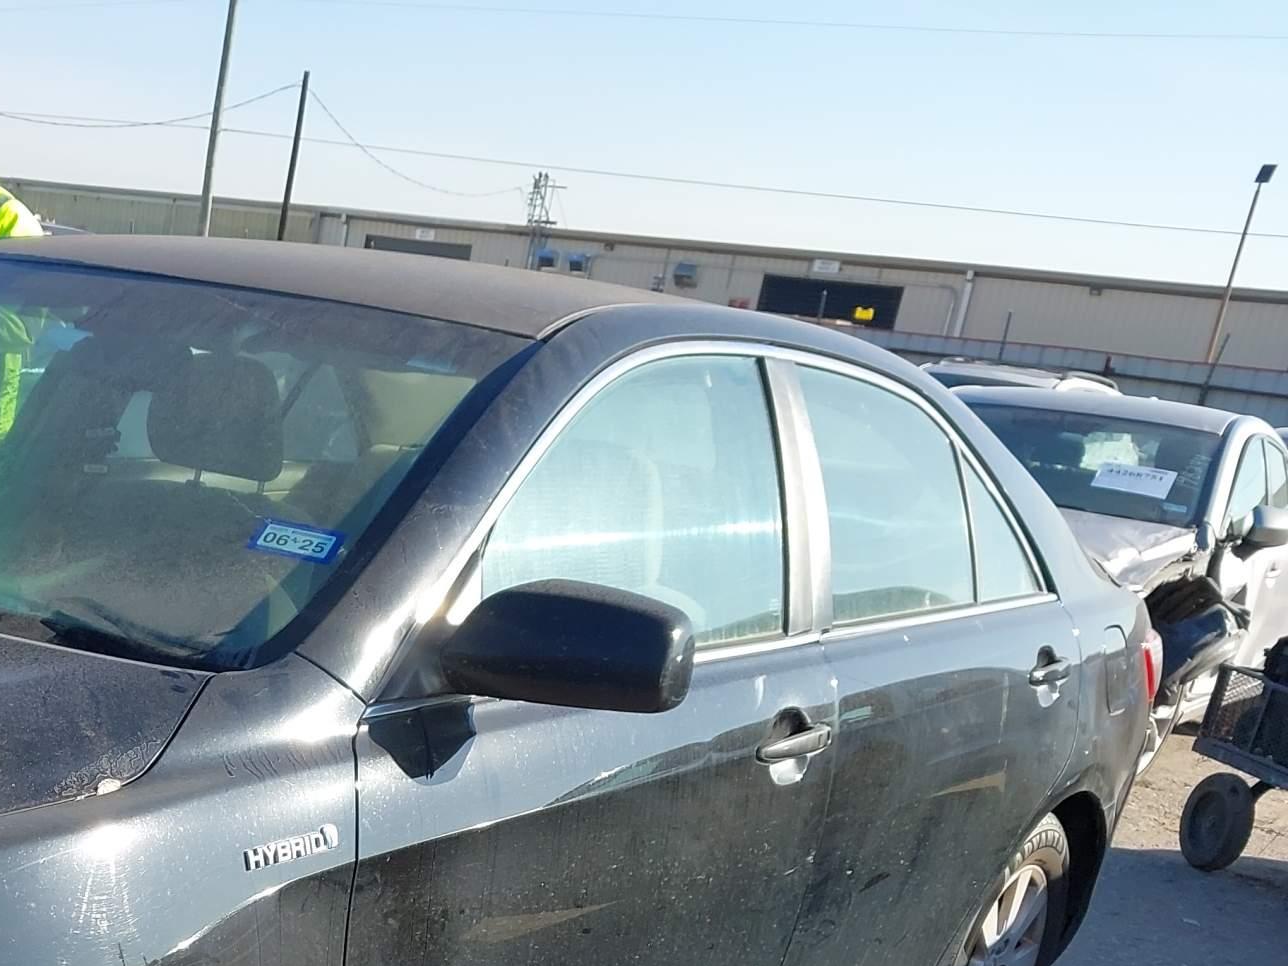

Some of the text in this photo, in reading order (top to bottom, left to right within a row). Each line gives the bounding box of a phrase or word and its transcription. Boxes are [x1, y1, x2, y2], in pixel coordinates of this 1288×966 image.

[263, 531, 328, 554] 06 25
[243, 831, 329, 872] HYBRID
